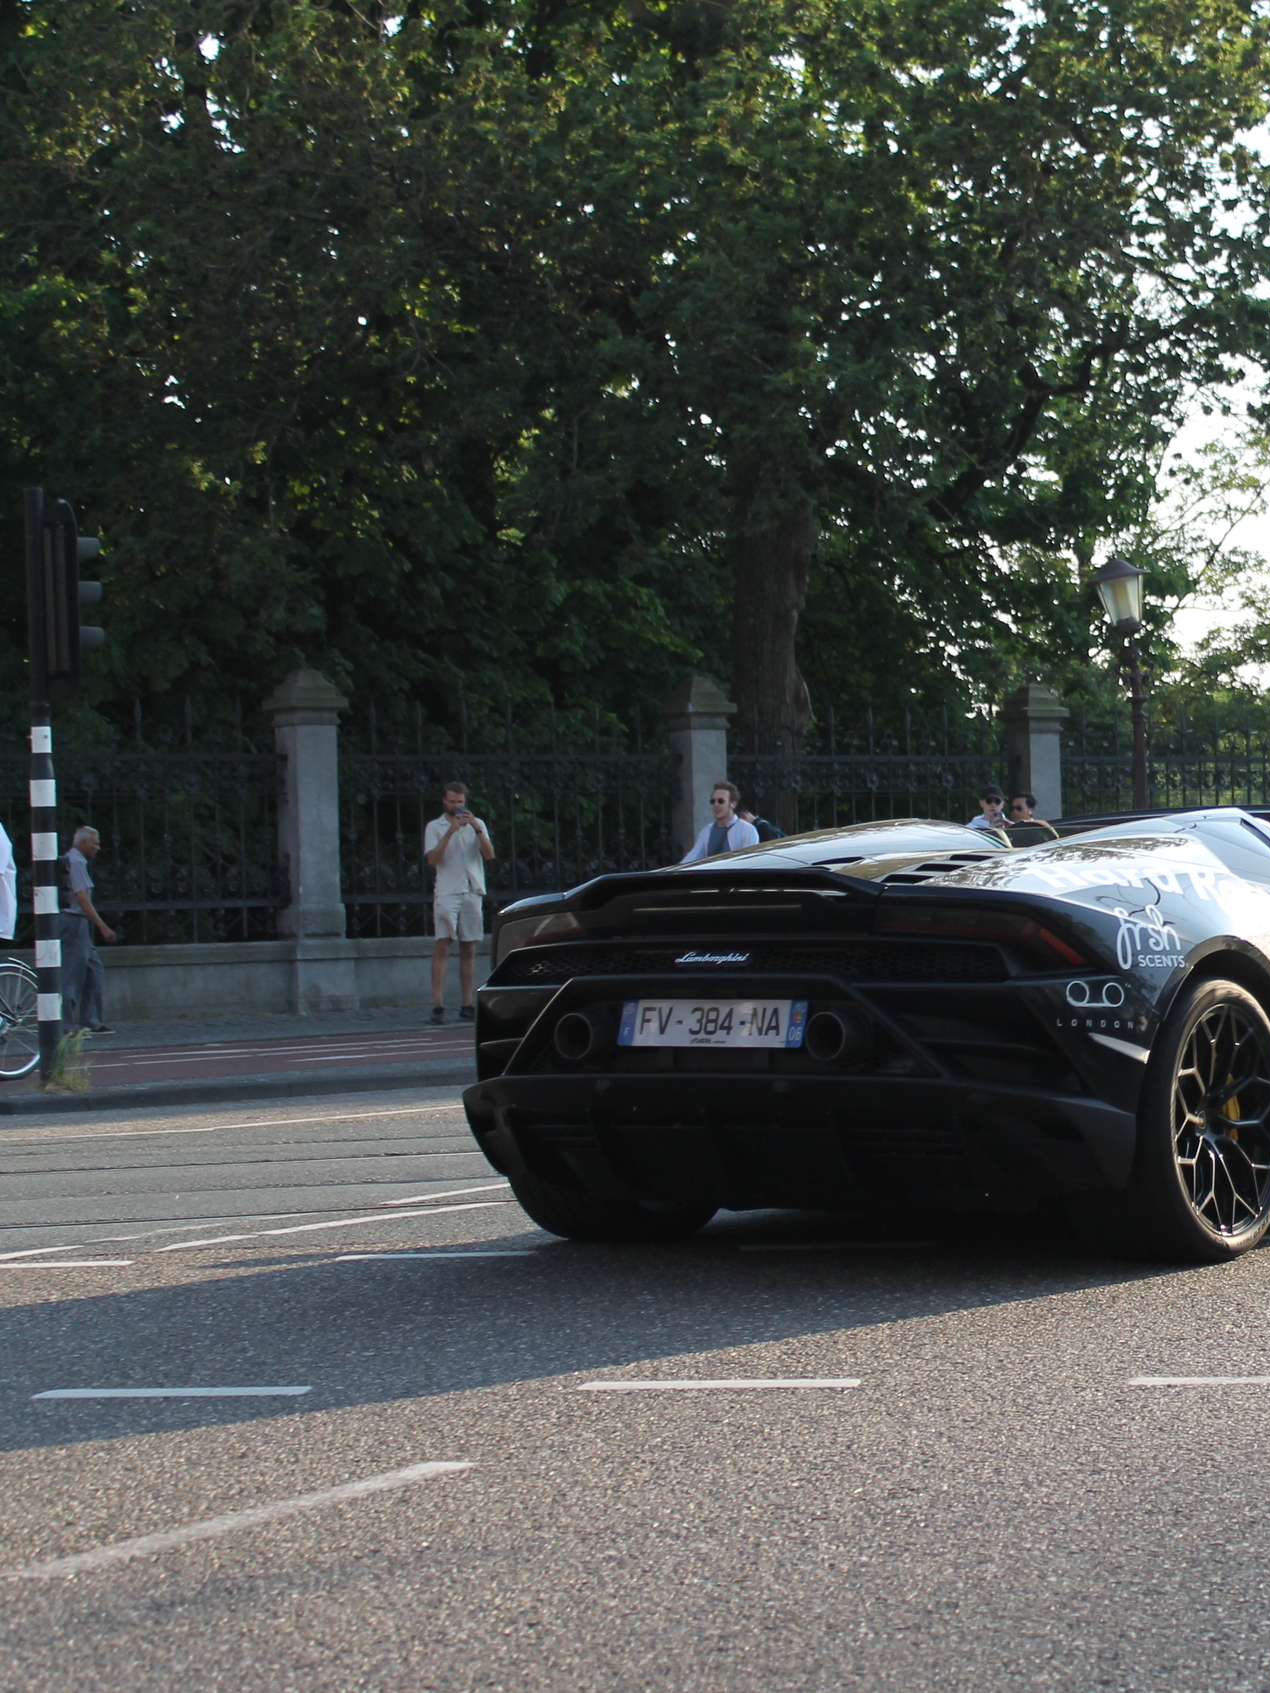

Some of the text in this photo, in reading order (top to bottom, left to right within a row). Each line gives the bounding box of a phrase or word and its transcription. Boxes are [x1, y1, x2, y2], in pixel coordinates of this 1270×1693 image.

[1022, 866, 1184, 895] Hard
[674, 951, 750, 965] Lamborghini
[1138, 955, 1186, 968] SCENTS
[1056, 1018, 1135, 1029] LONDON
[788, 1026, 802, 1041] 06
